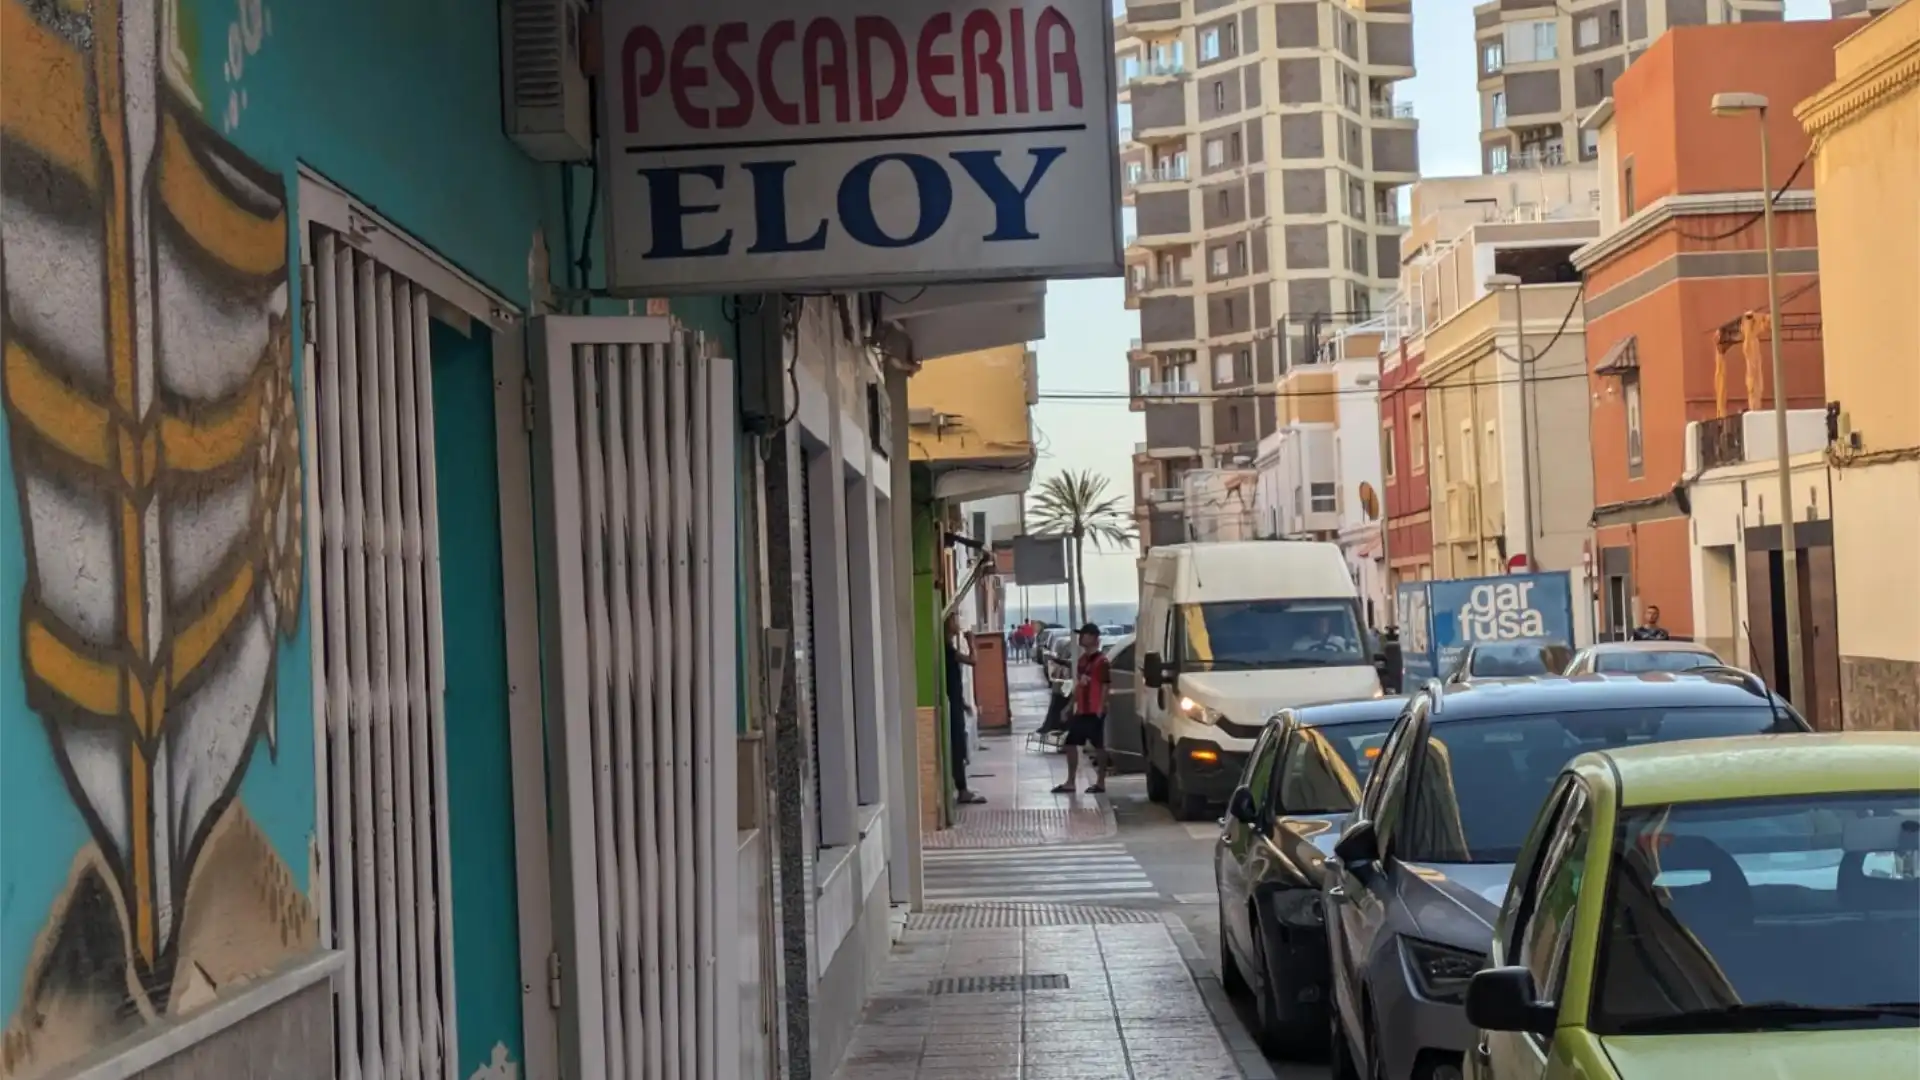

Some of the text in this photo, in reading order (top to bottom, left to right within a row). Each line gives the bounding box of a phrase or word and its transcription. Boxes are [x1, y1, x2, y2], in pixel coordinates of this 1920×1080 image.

[623, 6, 1083, 132] PESCADERIA
[638, 147, 1066, 259] ELOY
[1458, 602, 1544, 641] fusa
[1471, 581, 1534, 622] gar
